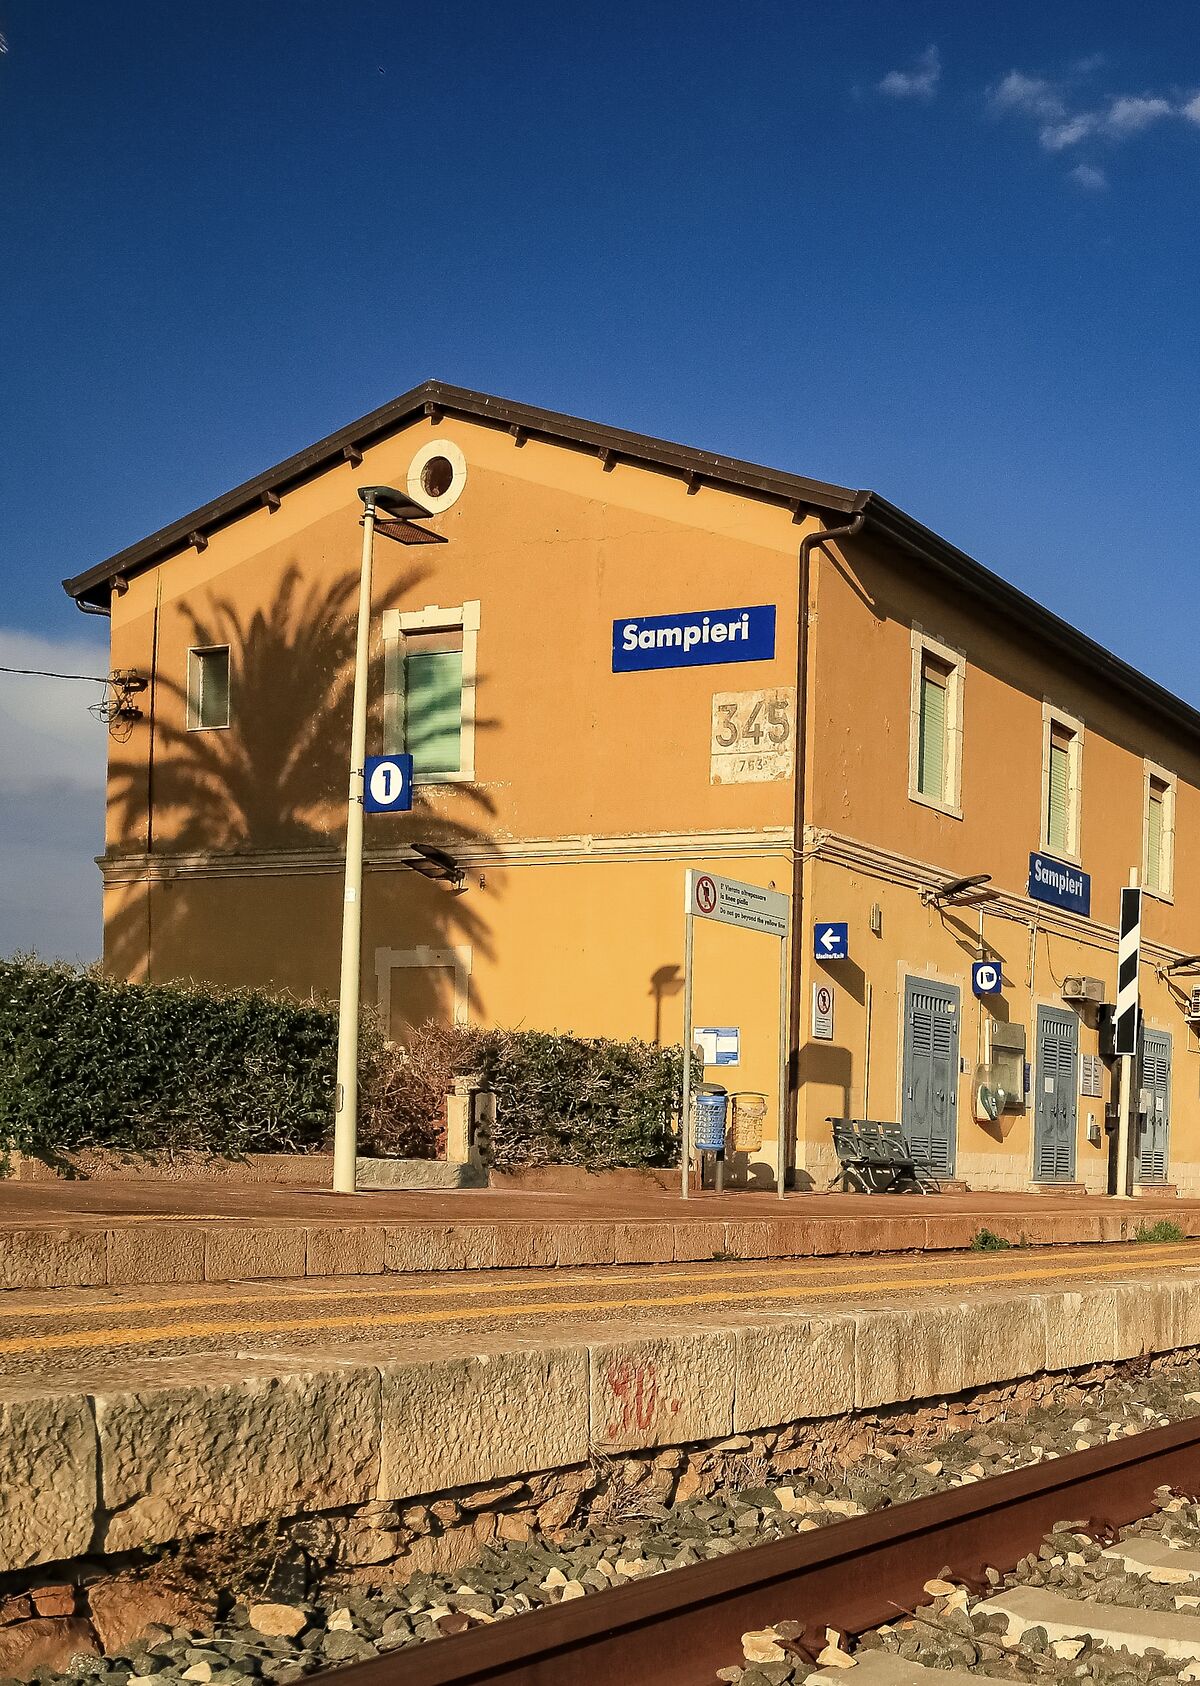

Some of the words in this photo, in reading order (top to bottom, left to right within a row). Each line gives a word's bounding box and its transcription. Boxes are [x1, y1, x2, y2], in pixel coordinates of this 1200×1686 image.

[622, 613, 749, 652] Sampieri
[715, 699, 790, 747] 345
[382, 769, 391, 797] 1
[1034, 859, 1083, 897] Sampieri
